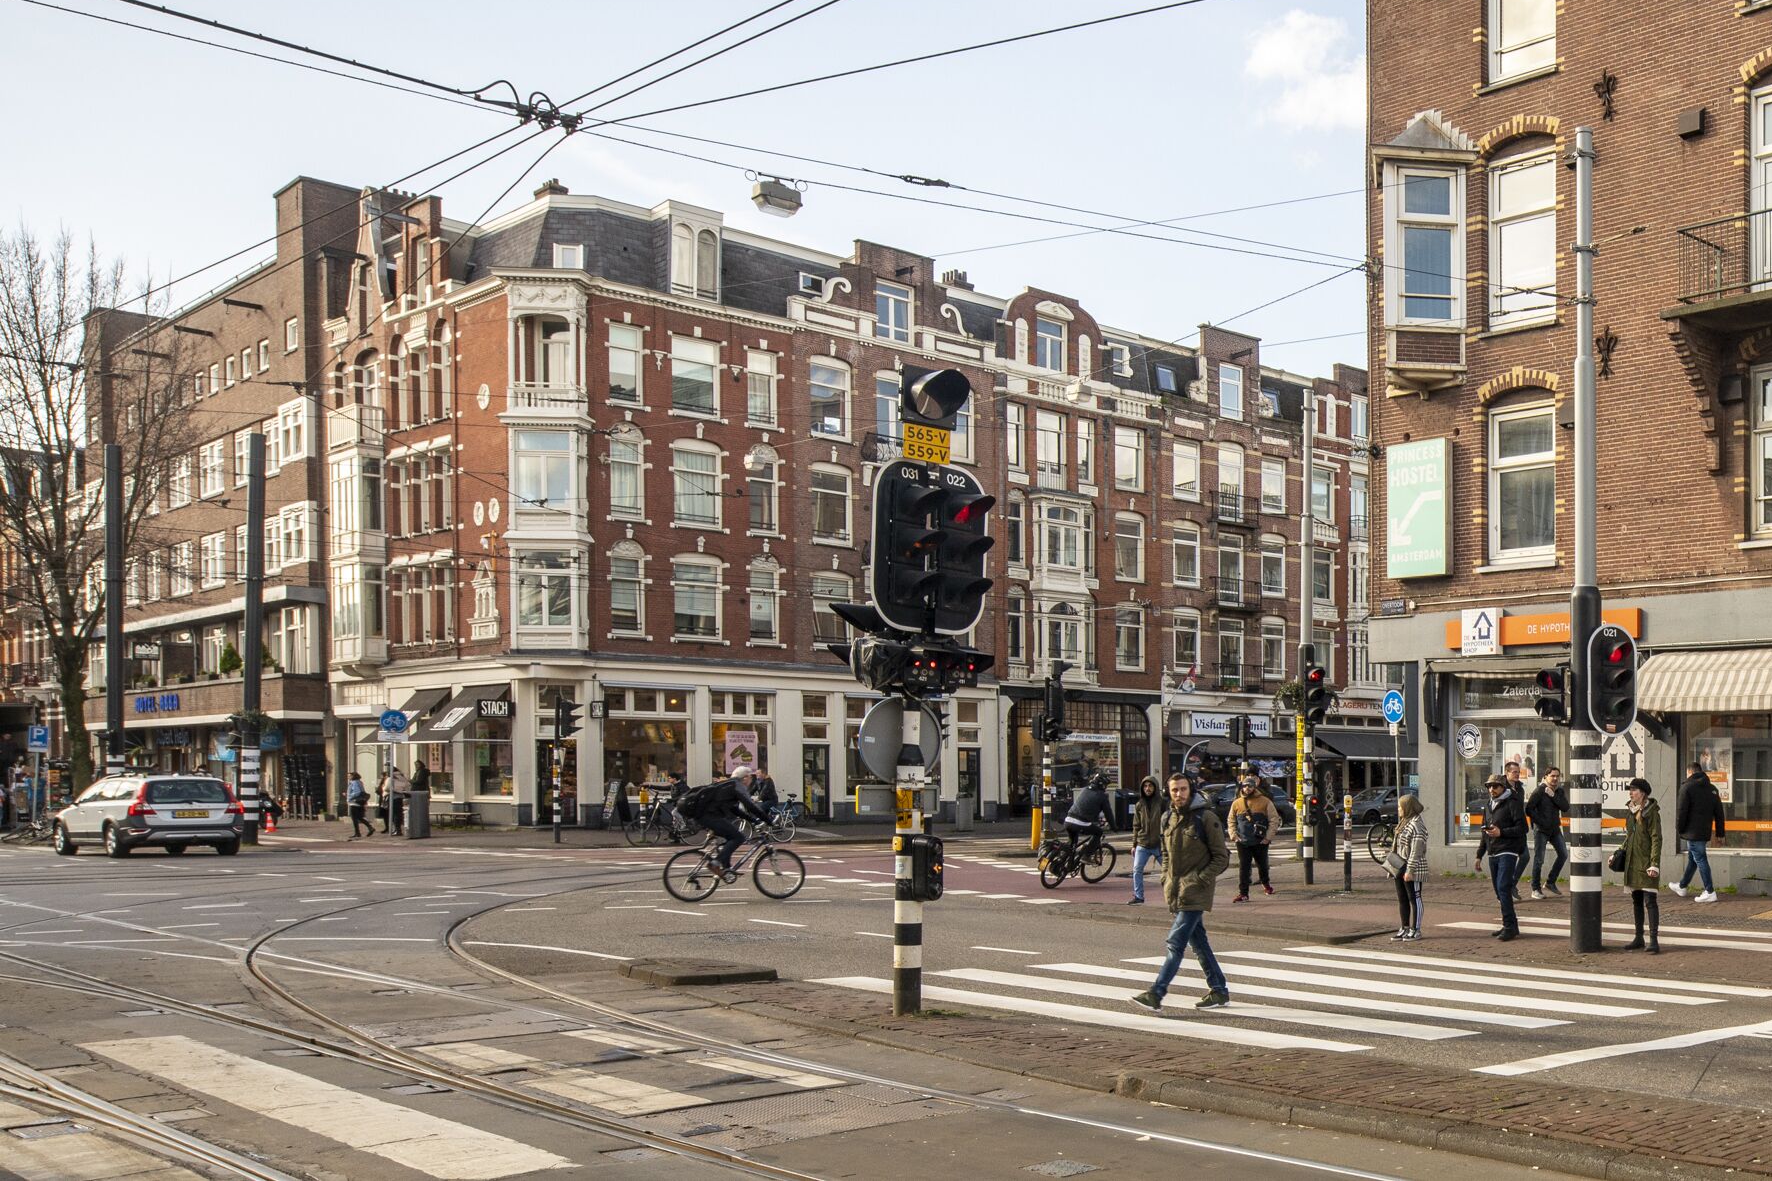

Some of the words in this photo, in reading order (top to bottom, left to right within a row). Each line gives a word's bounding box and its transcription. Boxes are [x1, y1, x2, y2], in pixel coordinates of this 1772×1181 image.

[907, 426, 947, 445] 565-V
[907, 443, 948, 462] 559-V
[1390, 444, 1442, 465] PRINCESS
[901, 466, 919, 480] 031
[1391, 464, 1440, 487] HOSTEL
[946, 473, 966, 488] 022
[1391, 549, 1443, 562] AMSTERDAM
[1527, 624, 1538, 634] DE
[1540, 622, 1571, 634] HYPOTH
[1603, 628, 1617, 637] 021
[1463, 640, 1494, 648] HYPOTHEEK
[481, 700, 508, 715] STACH
[1337, 701, 1368, 709] LAGERIJ
[1194, 718, 1230, 730] Vishan
[1249, 721, 1268, 732] mit
[33, 728, 44, 739] P
